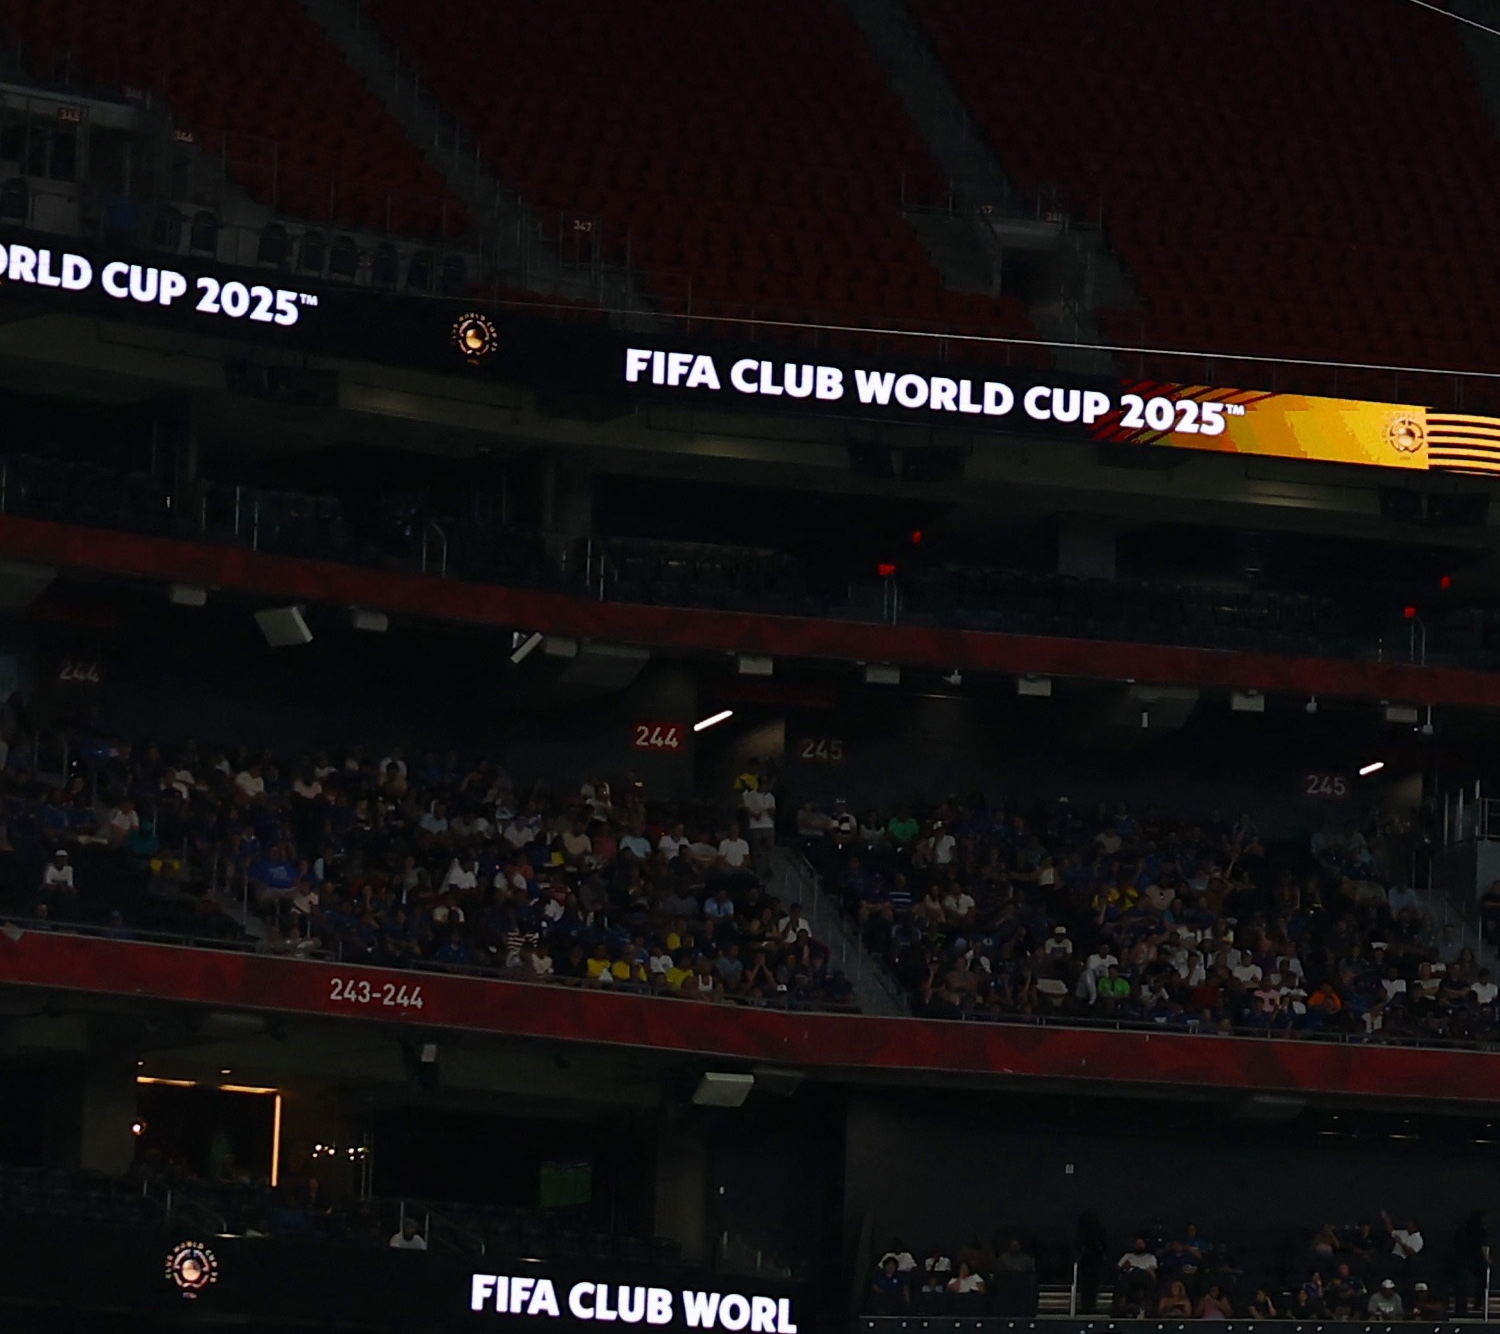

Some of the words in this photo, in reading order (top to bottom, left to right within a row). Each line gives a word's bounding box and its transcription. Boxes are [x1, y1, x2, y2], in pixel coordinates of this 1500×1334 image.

[0, 244, 93, 291] RLD
[102, 261, 187, 306] CUP
[626, 348, 720, 390] FIFA
[730, 358, 844, 401] CLUB
[854, 369, 1014, 415] WORLD
[1024, 386, 1110, 425] CUP
[635, 724, 678, 750] 244
[329, 977, 424, 1009] 243-244
[471, 1273, 560, 1317] FIFA
[568, 1281, 674, 1325] CLUB
[682, 1290, 798, 1334] WORL
